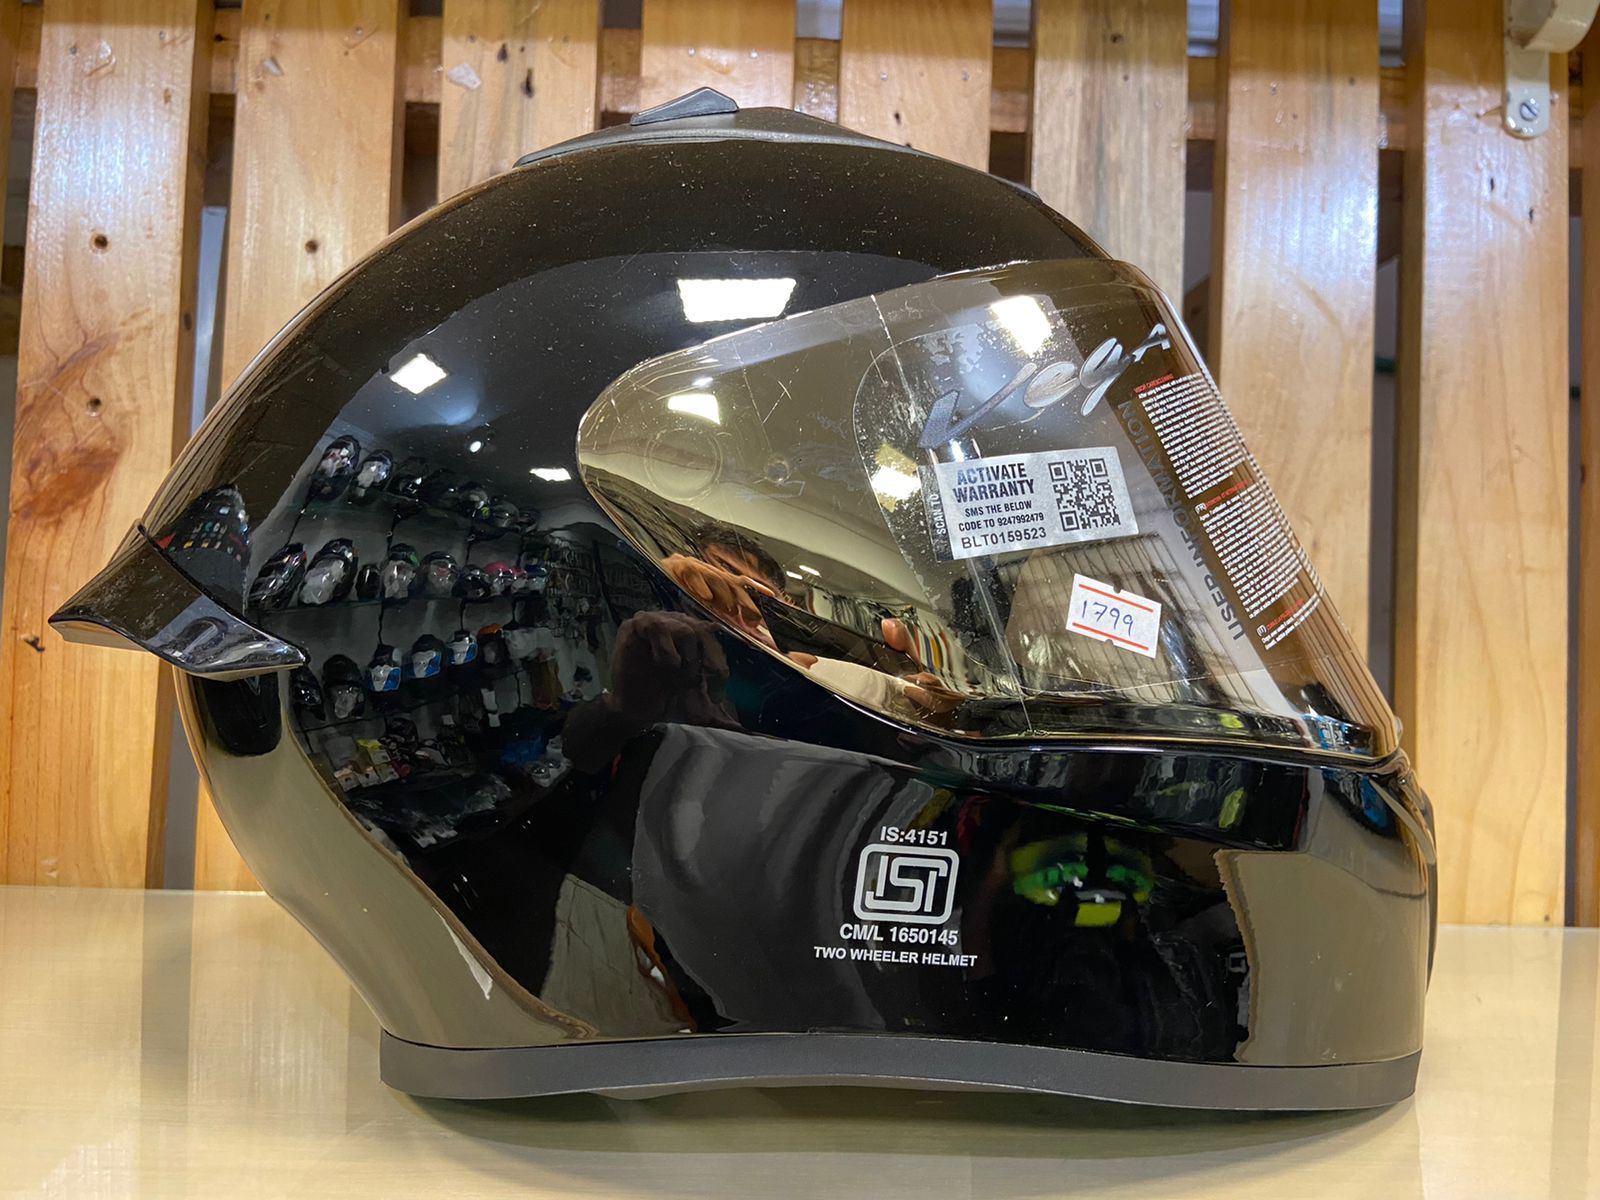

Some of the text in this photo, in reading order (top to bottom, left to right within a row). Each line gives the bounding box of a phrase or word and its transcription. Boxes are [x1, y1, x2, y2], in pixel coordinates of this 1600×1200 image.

[957, 463, 1027, 486] ACTIVATE
[1118, 400, 1206, 568] INFORMATION
[953, 479, 1035, 503] WARRANTY
[930, 494, 947, 535] SCAN TO
[965, 500, 1032, 517] SMS THE BELOW
[959, 512, 1044, 532] CODE TO 9247992479
[961, 527, 1047, 549] BLT0159523
[1082, 600, 1134, 636] 1799
[1203, 573, 1246, 641] USER
[880, 826, 948, 846] IS:4151
[839, 923, 958, 946] CM/L 1650145
[813, 946, 977, 967] TWO WHEELER HELMET
